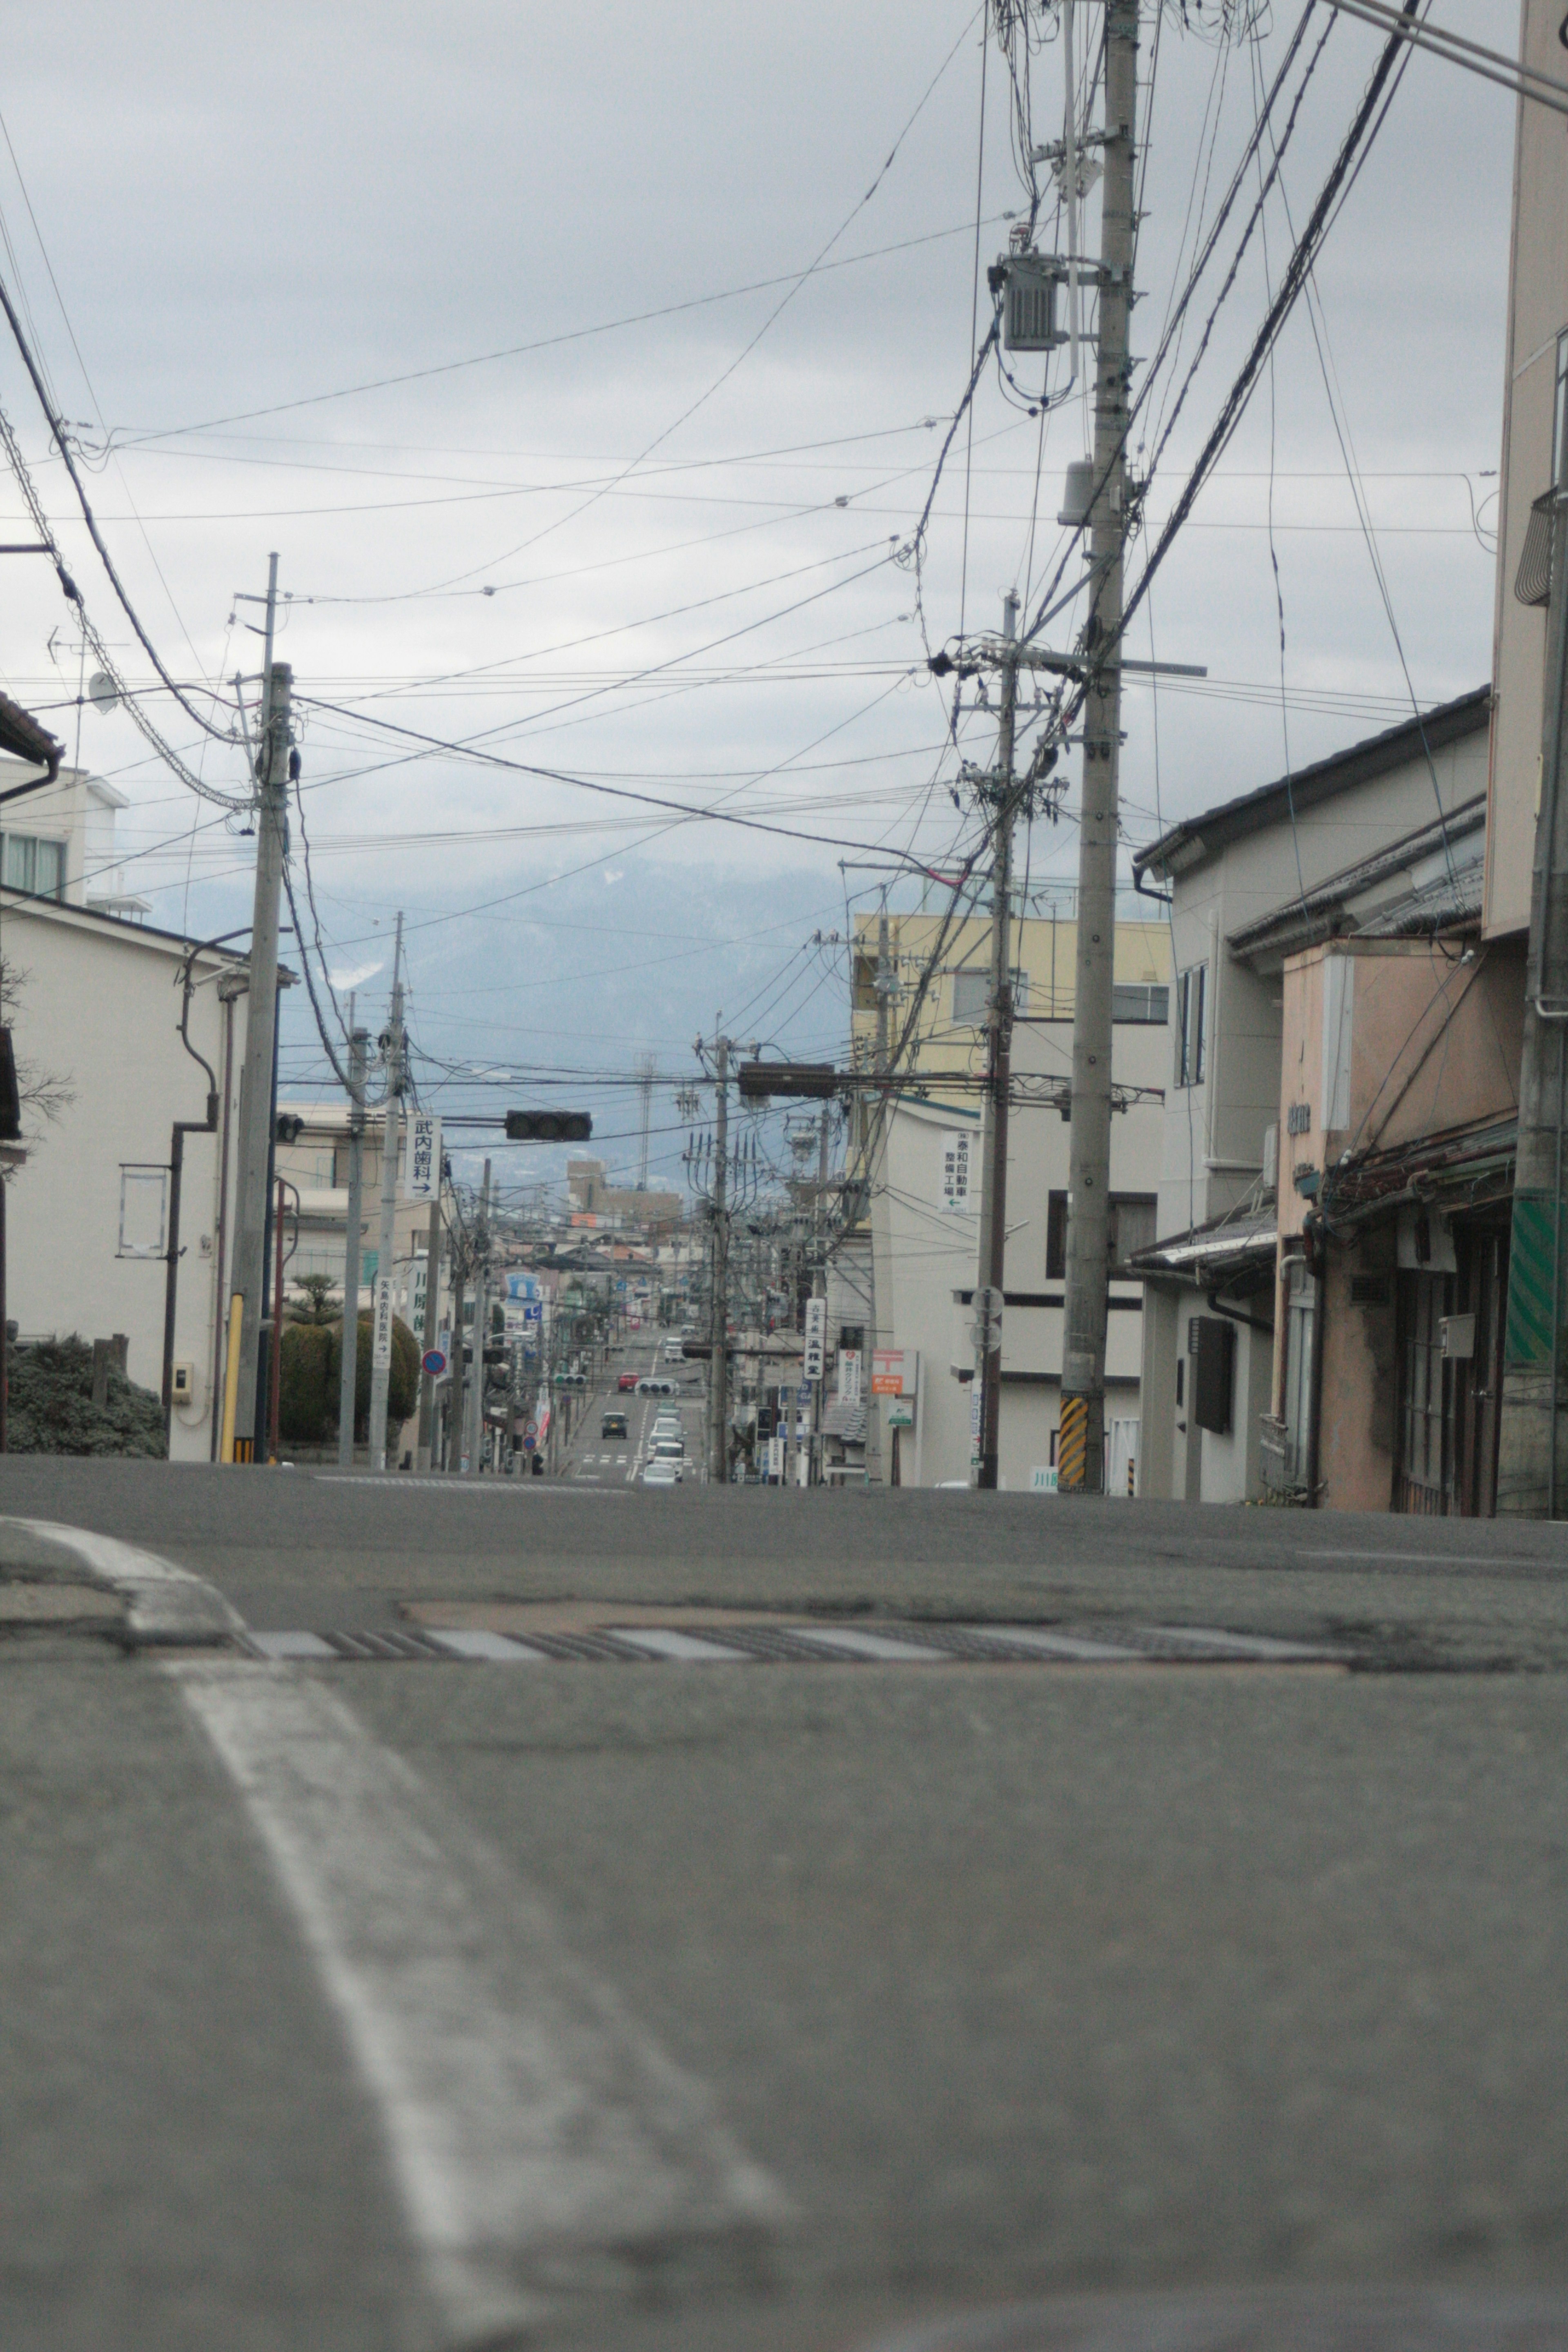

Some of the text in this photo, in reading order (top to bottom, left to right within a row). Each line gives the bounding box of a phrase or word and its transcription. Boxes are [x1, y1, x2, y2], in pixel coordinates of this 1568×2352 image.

[413, 1120, 433, 1180] 武内歯科
[944, 1152, 955, 1196] 整備工場
[379, 1280, 390, 1342] 矢島内科医院
